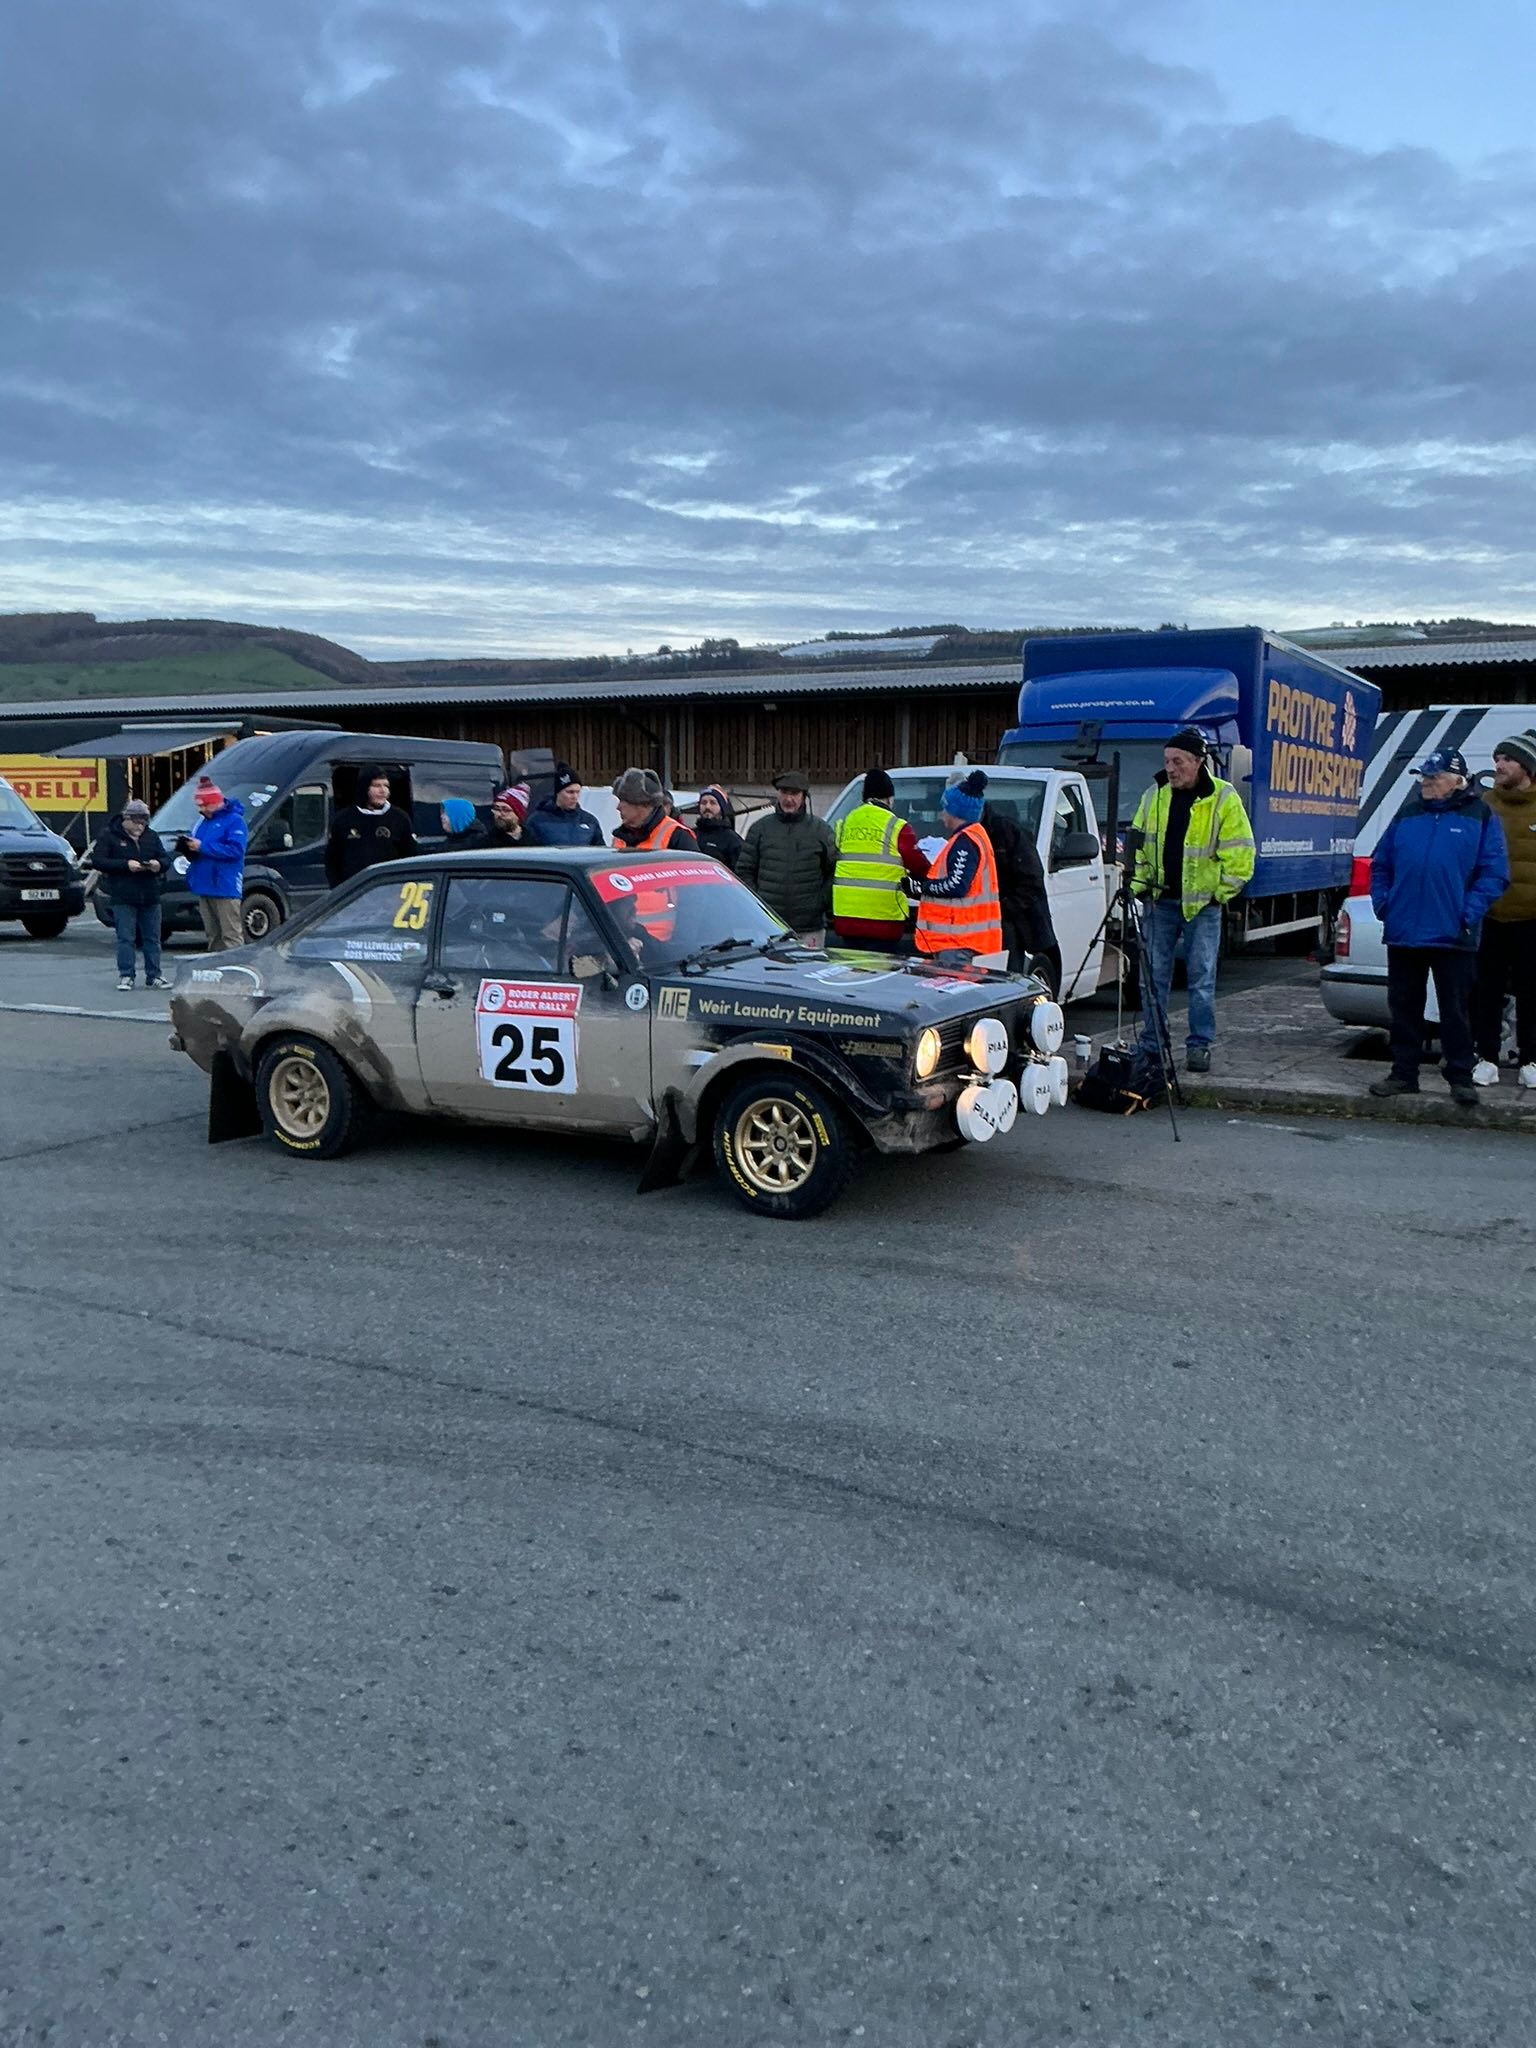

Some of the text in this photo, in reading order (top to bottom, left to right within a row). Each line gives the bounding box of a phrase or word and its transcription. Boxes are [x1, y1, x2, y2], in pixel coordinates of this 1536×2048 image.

[1266, 679, 1337, 748] PROTYRE
[1269, 739, 1364, 800] MOTORSPORT
[2, 775, 98, 799] RELLI
[393, 881, 434, 930] 25
[346, 940, 403, 951] TOM LLEWELLIN
[343, 950, 402, 961] ROSS WHITTOCK
[192, 969, 224, 982] WEIR
[508, 989, 577, 1002] ROGER ALBERT
[506, 1000, 568, 1012] CLARK RALLY
[699, 999, 882, 1028] Weir Laundry Equipment
[1047, 1022, 1063, 1034] PIAA
[492, 1023, 565, 1087] 25
[988, 1040, 1007, 1053] PIAA
[1036, 1084, 1051, 1095] PIAA
[973, 1101, 996, 1128] PIAA
[723, 1131, 758, 1198] SCORPION
